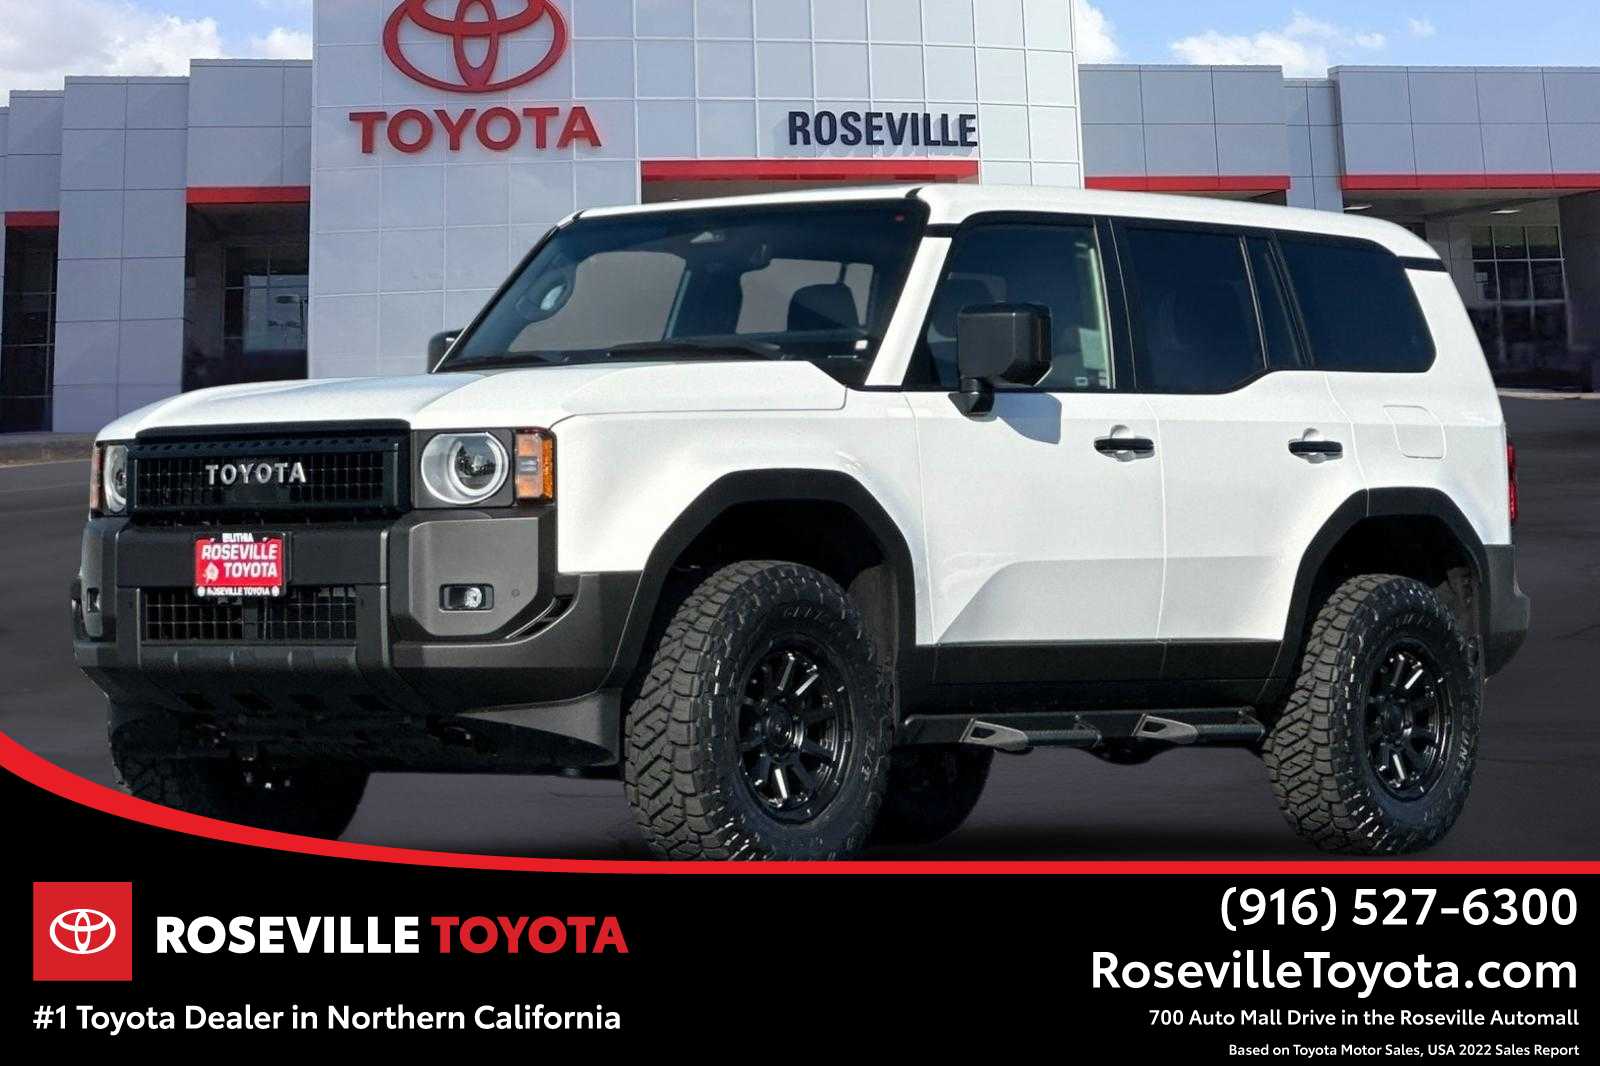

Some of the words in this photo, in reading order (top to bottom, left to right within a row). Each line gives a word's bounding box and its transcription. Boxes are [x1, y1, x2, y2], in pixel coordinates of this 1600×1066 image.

[349, 105, 602, 154] TOYOTA
[788, 110, 979, 148] ROSEVILLE
[205, 462, 307, 485] TOYOTA
[202, 544, 278, 560] ROSEVILLE
[223, 562, 277, 577] TOYOTA
